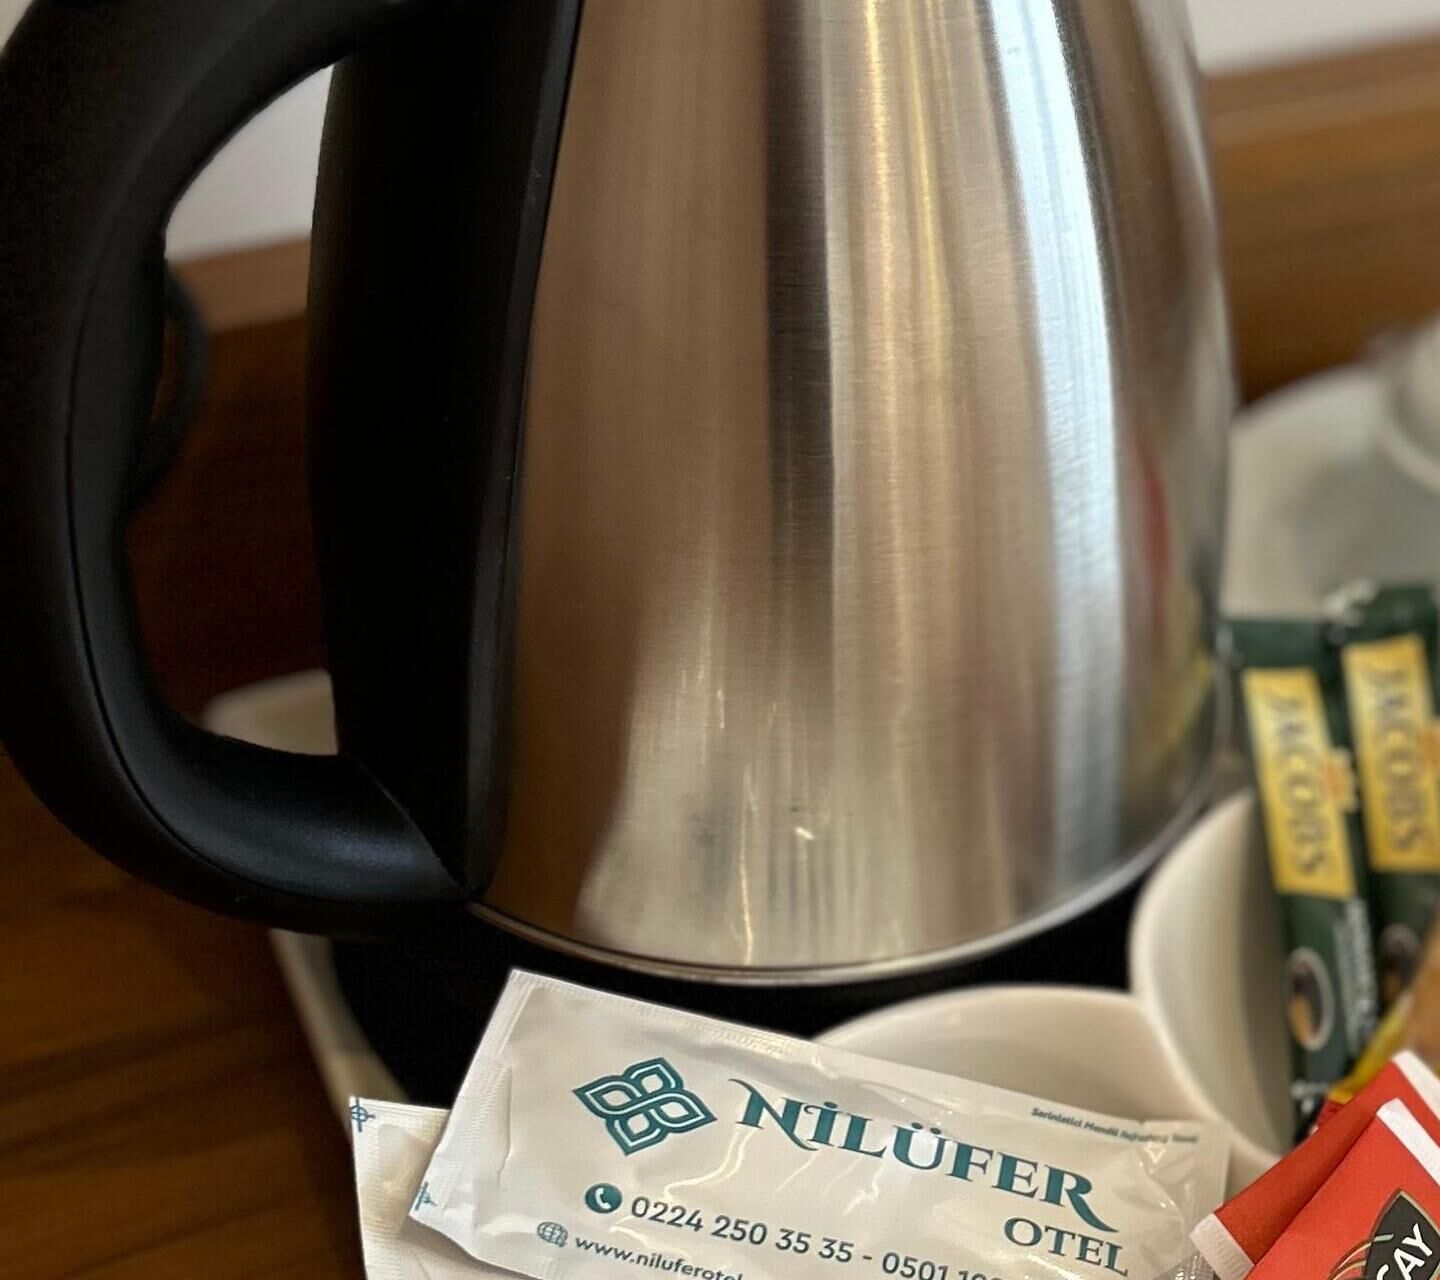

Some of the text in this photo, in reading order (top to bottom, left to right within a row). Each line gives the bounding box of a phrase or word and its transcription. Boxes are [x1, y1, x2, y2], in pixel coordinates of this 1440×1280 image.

[728, 1078, 1119, 1234] NİLÜFER
[631, 1196, 704, 1233] 0224
[711, 1214, 768, 1246] 250
[775, 1227, 812, 1255] 35
[818, 1236, 855, 1264] 35
[1003, 1216, 1130, 1278] OTEL
